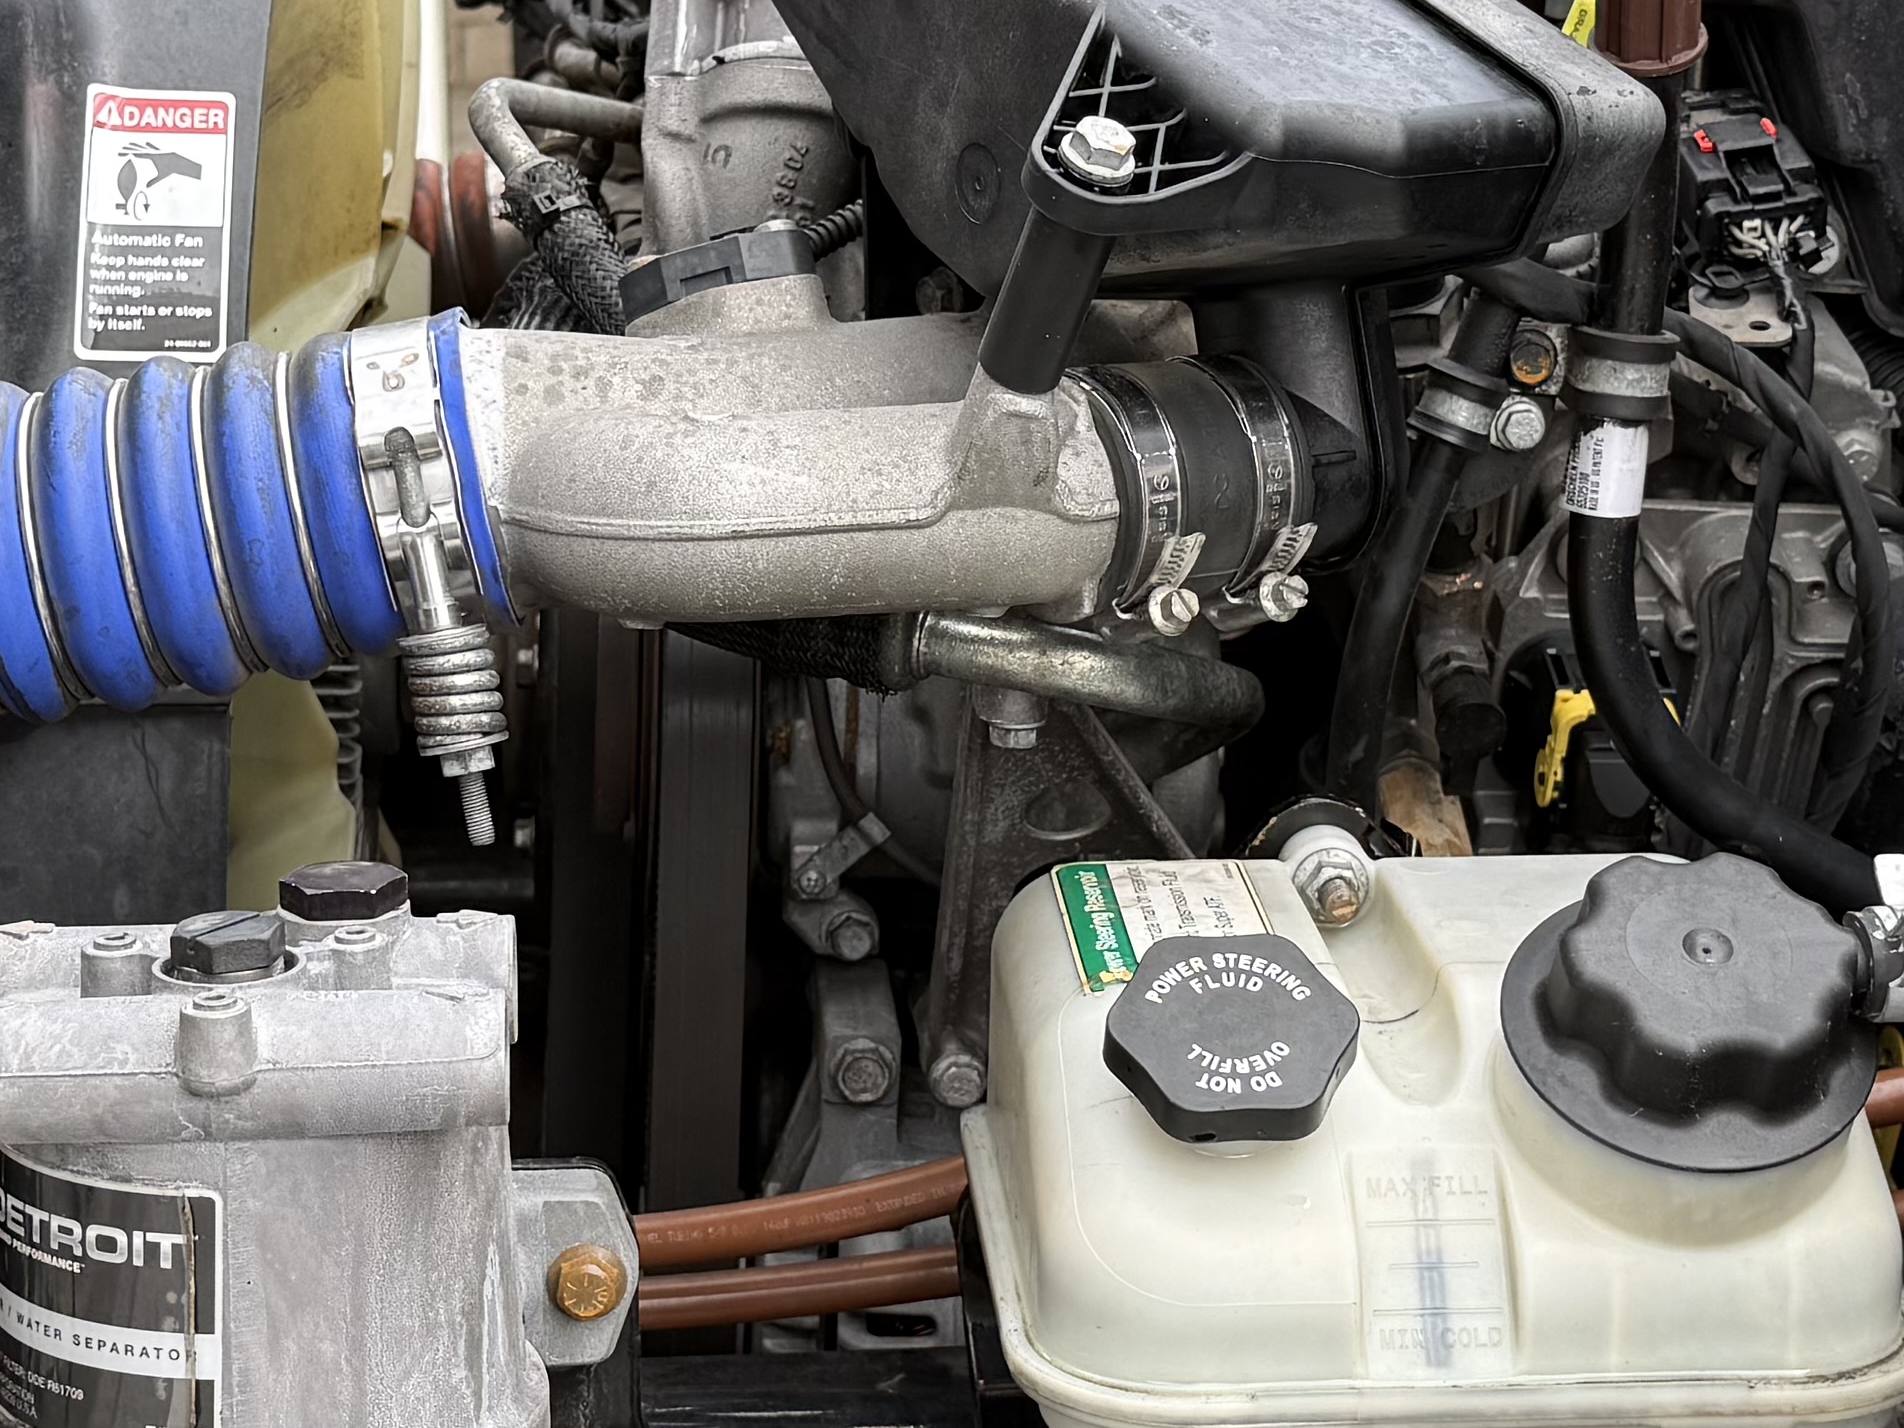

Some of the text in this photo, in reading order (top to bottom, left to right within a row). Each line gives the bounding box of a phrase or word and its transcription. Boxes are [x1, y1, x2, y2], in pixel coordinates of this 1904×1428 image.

[124, 106, 225, 130] DANGER
[91, 232, 204, 248] Automatic Fan
[90, 253, 205, 268] Keep hands clear
[90, 268, 188, 284] when engine is
[89, 283, 145, 298] running.
[89, 303, 213, 318] Fan starts or stops
[107, 318, 145, 331] itself.
[1074, 870, 1107, 912] Reservoir
[1159, 870, 1199, 929] Transmission Fluid
[1089, 911, 1119, 950] Steering
[1144, 952, 1313, 1005] POWER STEERING
[1188, 971, 1265, 996] FLUID
[1186, 1041, 1291, 1074] OVERFILL
[1194, 1071, 1284, 1094] DO NOT
[1366, 1173, 1489, 1199] MAX FILL
[17, 1312, 63, 1341] WATER
[1379, 1326, 1503, 1350] MIN COLD
